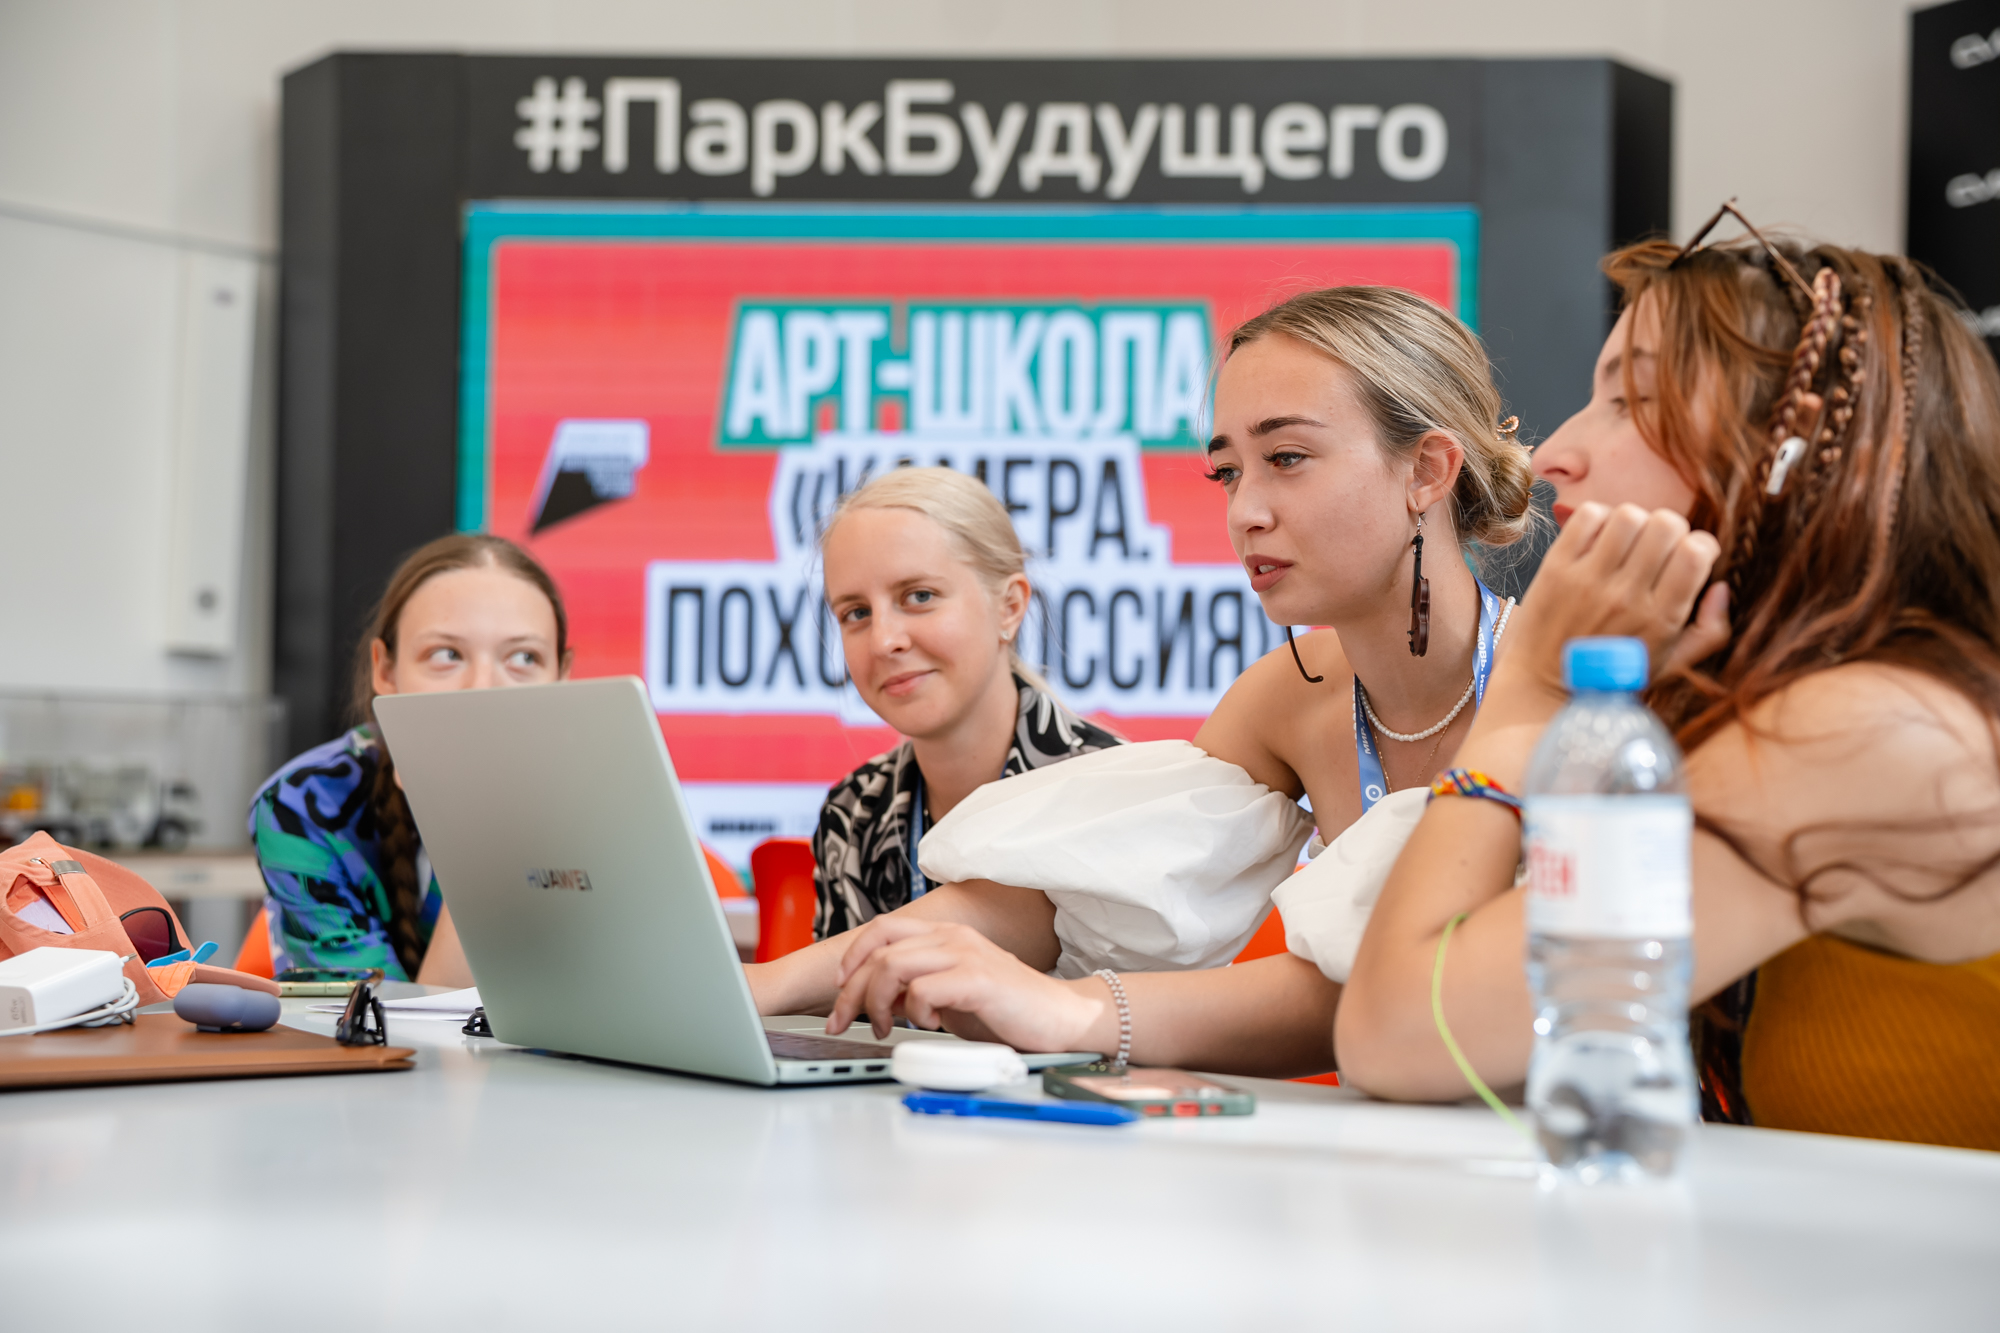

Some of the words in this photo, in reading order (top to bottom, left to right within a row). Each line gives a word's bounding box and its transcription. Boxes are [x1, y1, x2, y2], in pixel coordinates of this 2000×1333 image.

[515, 76, 1448, 199] #ПаркБудущего
[726, 310, 1213, 438] АРТ-ШКОЛА
[789, 456, 1148, 559] «ЕРА.
[525, 867, 593, 892] HUAWEI
